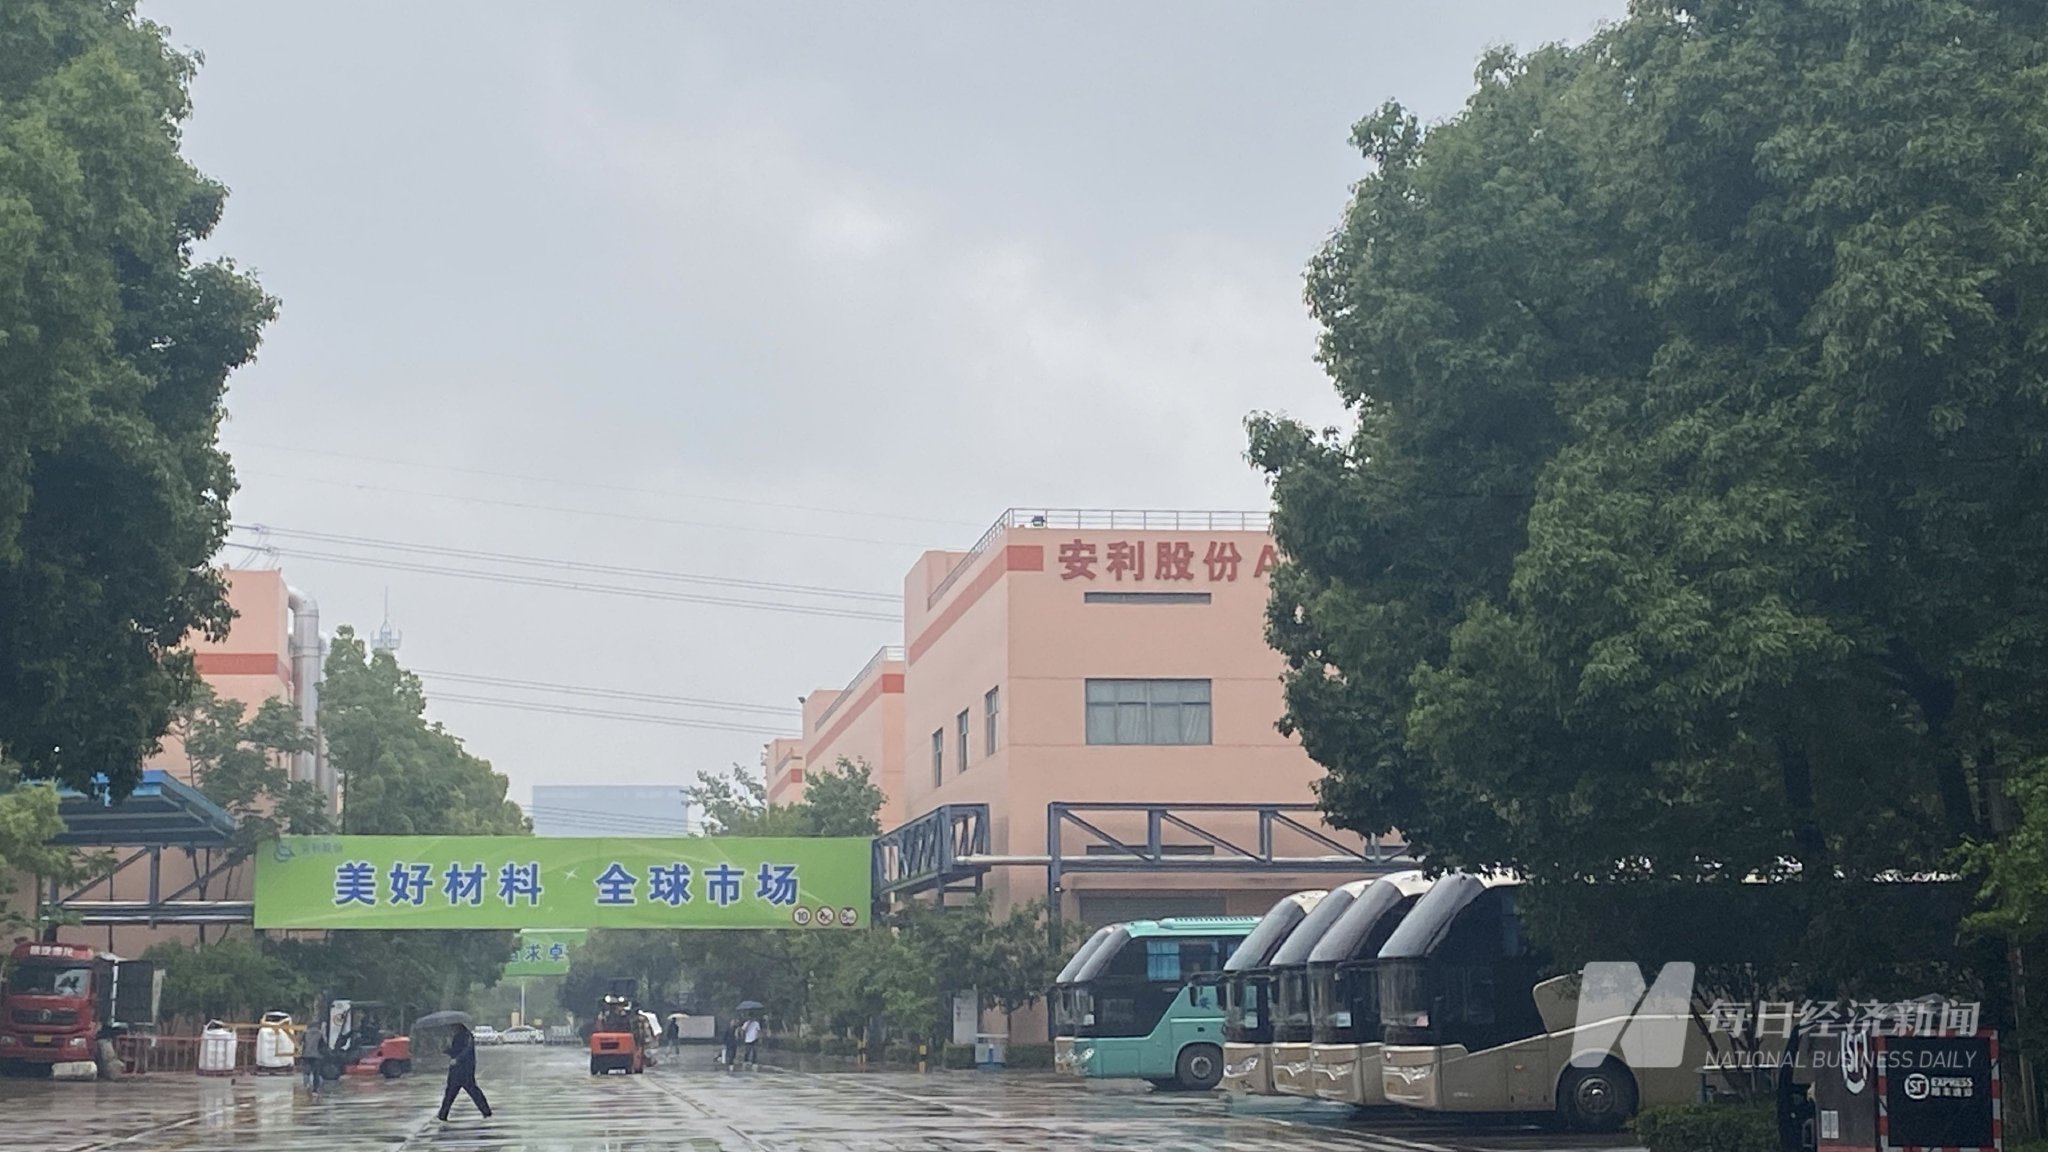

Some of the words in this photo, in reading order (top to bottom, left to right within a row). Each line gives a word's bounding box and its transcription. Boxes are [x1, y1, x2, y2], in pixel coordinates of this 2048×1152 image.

[1058, 538, 1242, 582] 安利股份
[334, 861, 544, 906] 美好材料
[595, 861, 800, 906] 全球市场
[797, 911, 809, 922] 10
[1930, 1077, 1974, 1087] EXPRESS
